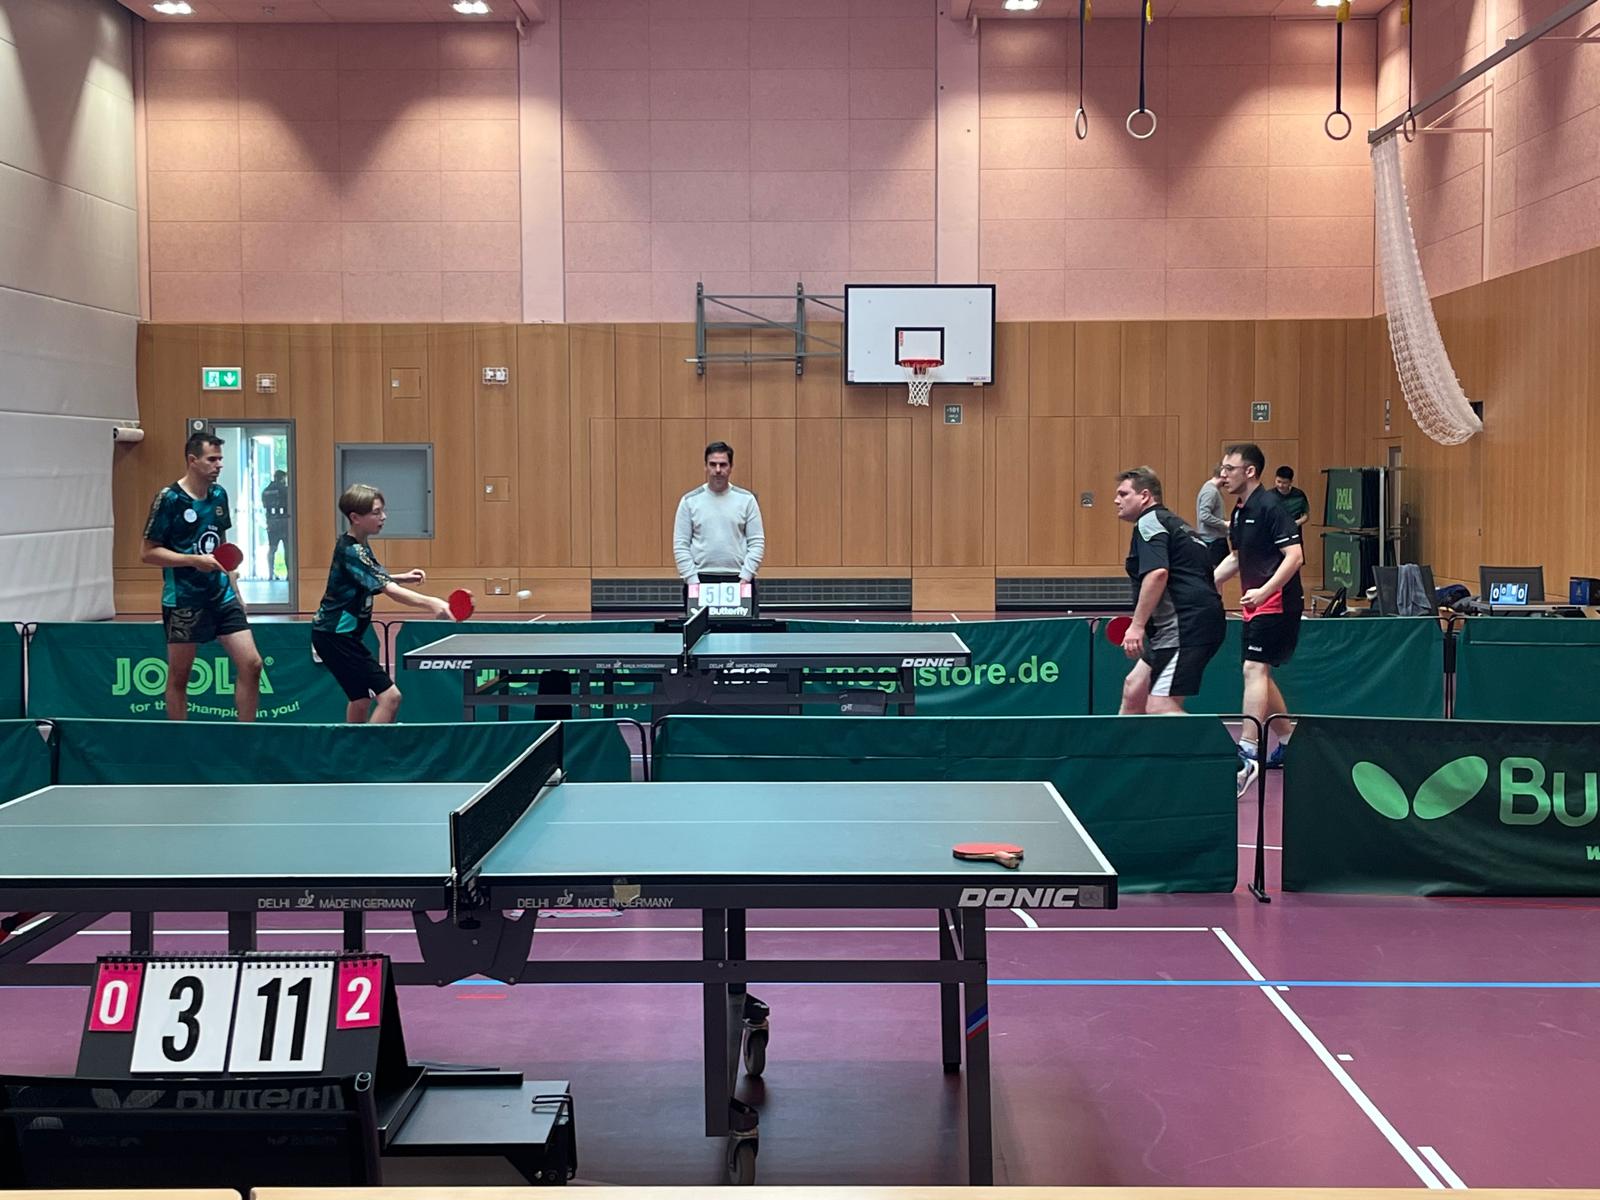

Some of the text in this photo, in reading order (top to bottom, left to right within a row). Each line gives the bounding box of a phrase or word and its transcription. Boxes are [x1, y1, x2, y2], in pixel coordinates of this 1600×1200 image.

[706, 586, 735, 603] 5 9
[708, 607, 749, 616] Butterfly
[419, 660, 473, 669] DONIC
[901, 658, 956, 667] DONIC
[130, 703, 151, 713] for
[272, 701, 300, 718] you!
[1500, 757, 1599, 827] Bu
[257, 899, 416, 909] DELHI MADE IN GERMANY
[517, 898, 674, 908] DELHI MADE IN GERMANY
[958, 888, 1079, 907] DONIC
[98, 975, 372, 1062] 0 3 11 2
